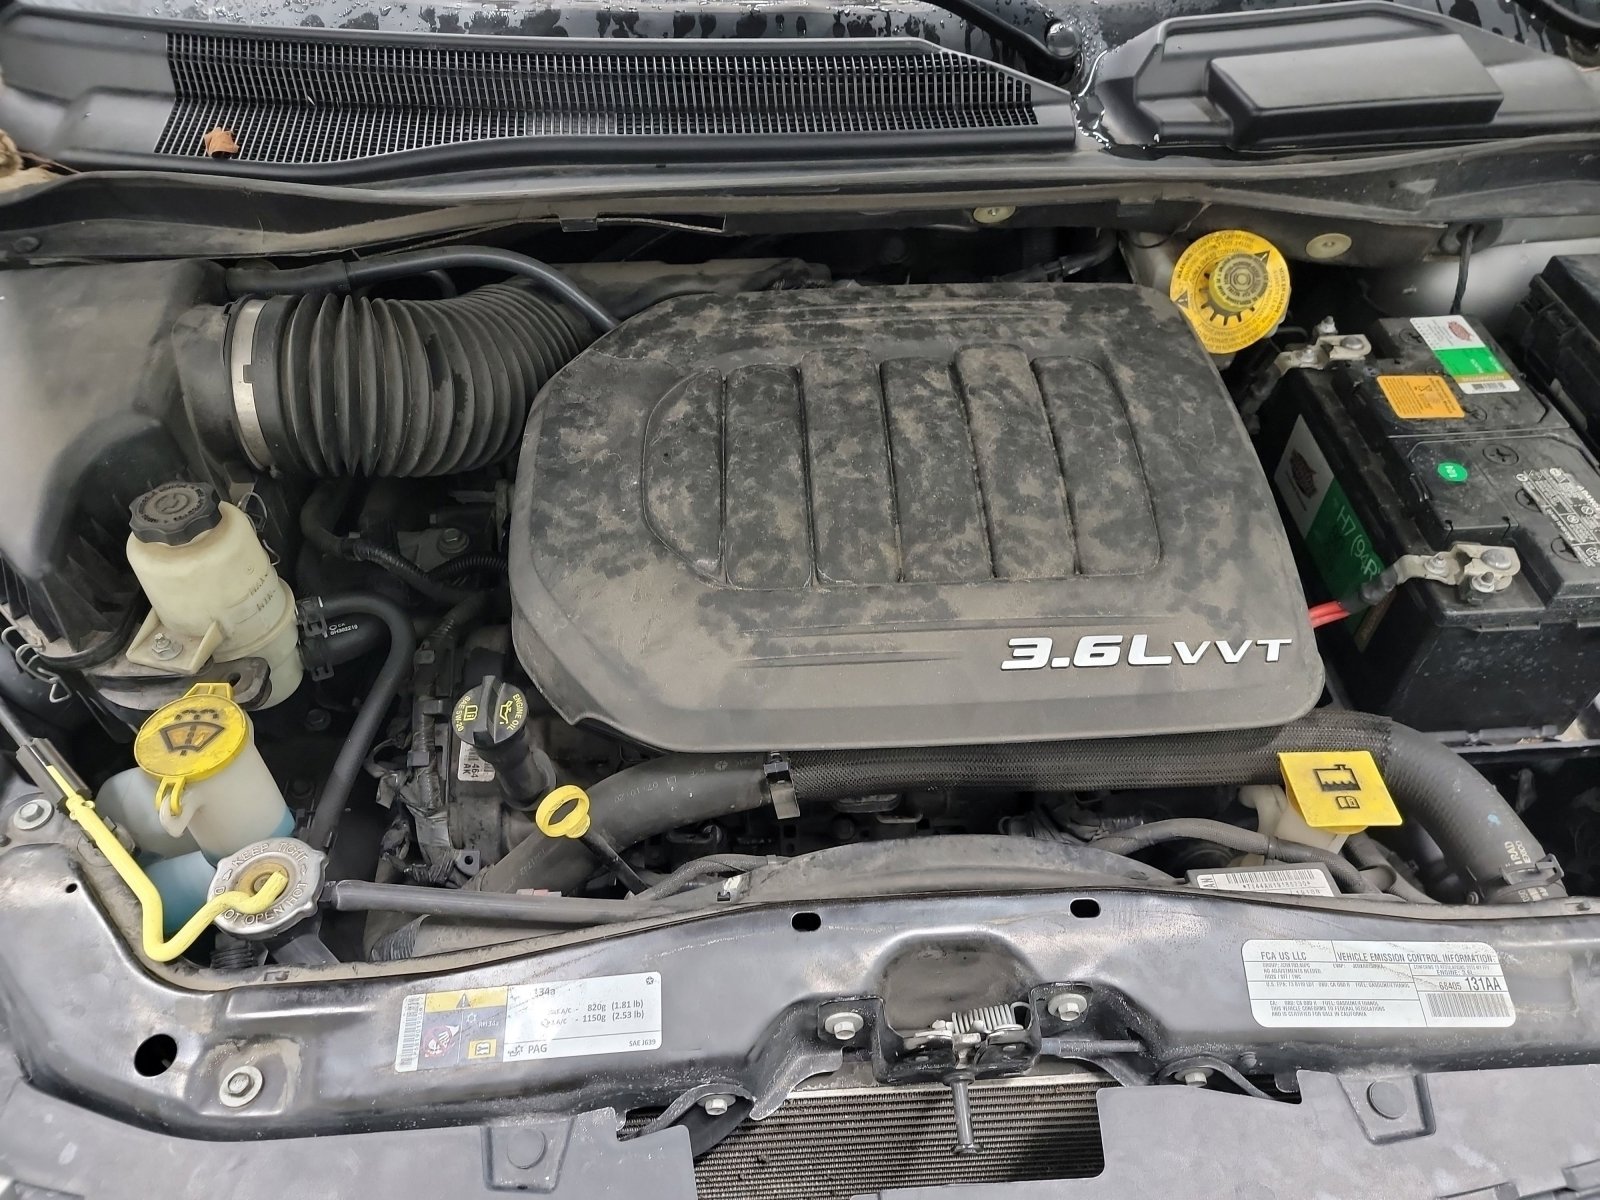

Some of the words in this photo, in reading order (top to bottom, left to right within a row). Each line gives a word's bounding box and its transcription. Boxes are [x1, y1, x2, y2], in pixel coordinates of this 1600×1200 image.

[458, 695, 471, 710] SAE
[512, 693, 524, 719] ENGINE
[506, 719, 519, 731] OIL
[231, 842, 270, 868] KEEP
[278, 841, 309, 861] TIGHT
[214, 885, 226, 895] D
[223, 908, 243, 923] OT
[244, 903, 286, 925] OPEN
[286, 880, 309, 907] HOT
[1260, 951, 1277, 961] FCA
[1279, 951, 1291, 961] US
[1292, 951, 1307, 961] LLC
[1336, 952, 1368, 962] VEHICLE
[1370, 952, 1405, 962] EMISSION
[1406, 953, 1441, 963] CONTROL
[1442, 953, 1493, 963] INFORMATION
[1438, 981, 1462, 991] 68405
[1465, 976, 1502, 991] 131AA
[587, 1003, 607, 1012] 820g
[611, 1000, 631, 1011] (1.81
[633, 999, 644, 1009] lb)
[582, 1013, 606, 1023] 1150g
[612, 1011, 632, 1021] (2.53
[634, 1009, 645, 1019] lb)
[527, 1043, 548, 1054] PAG
